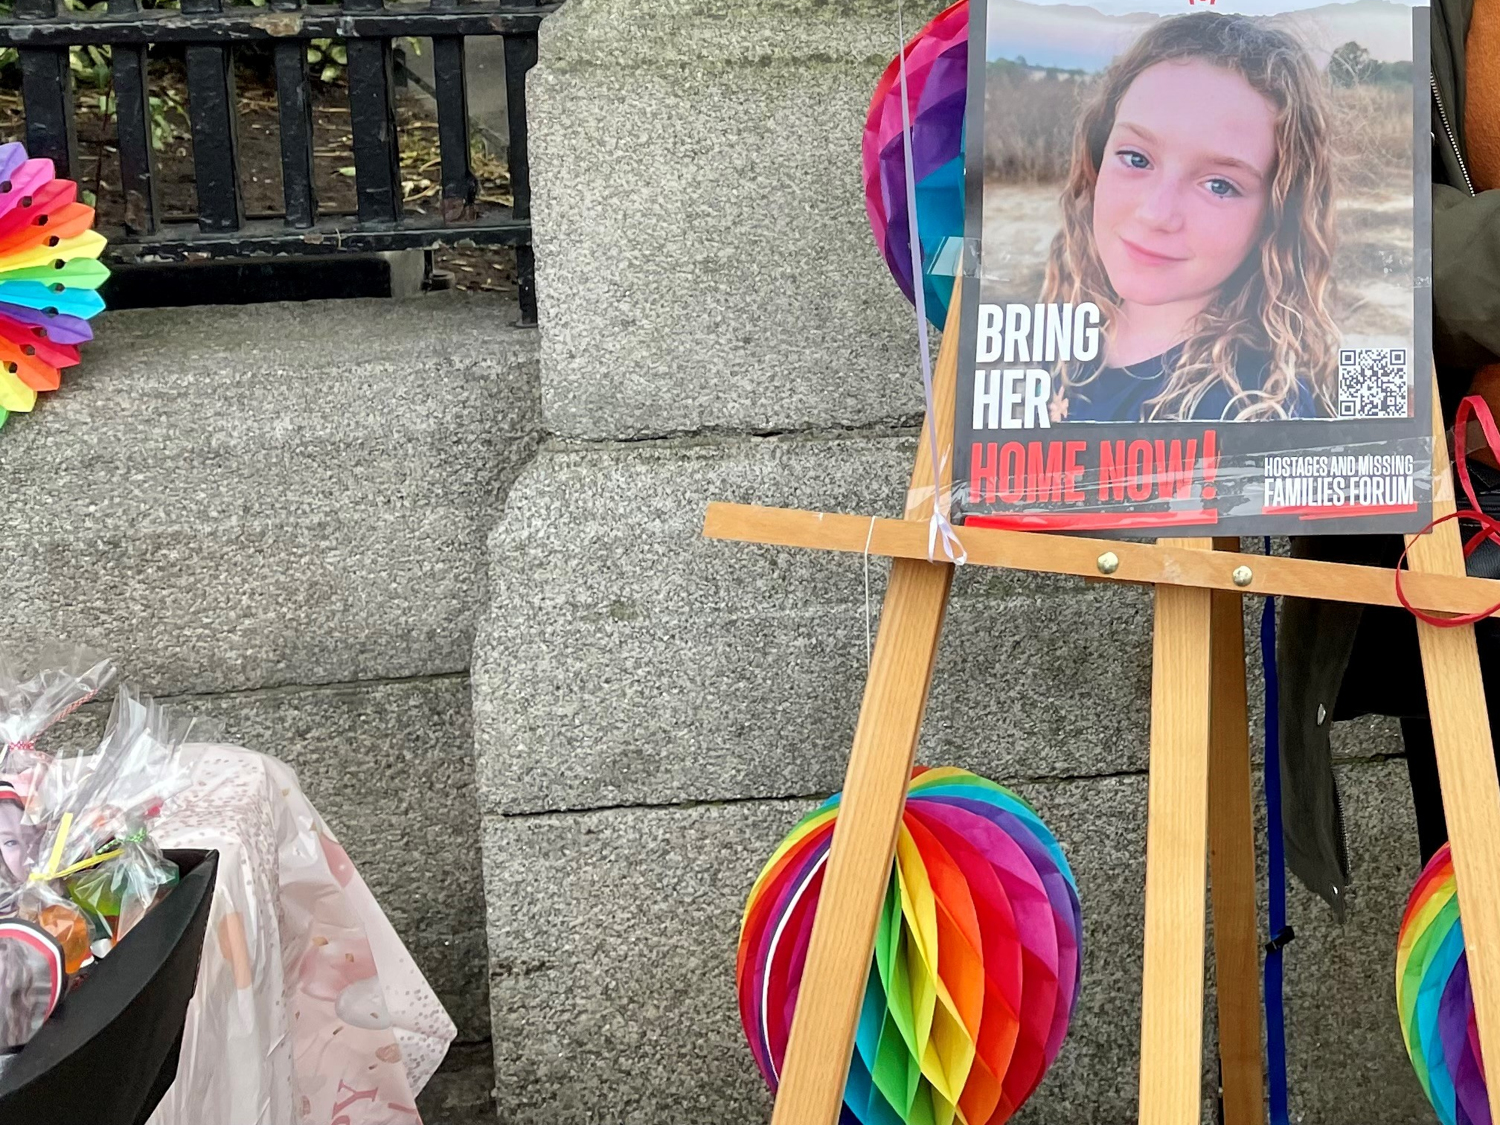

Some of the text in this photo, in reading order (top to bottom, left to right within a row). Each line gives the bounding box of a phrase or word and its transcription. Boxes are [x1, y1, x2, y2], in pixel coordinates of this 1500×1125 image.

[975, 302, 1100, 363] BRING
[972, 369, 1051, 430] HER
[969, 430, 1218, 504] HOME NOW!
[1263, 455, 1414, 477] HOSTAGES AND MISSING
[1263, 475, 1414, 508] FAMILIES FORUM
